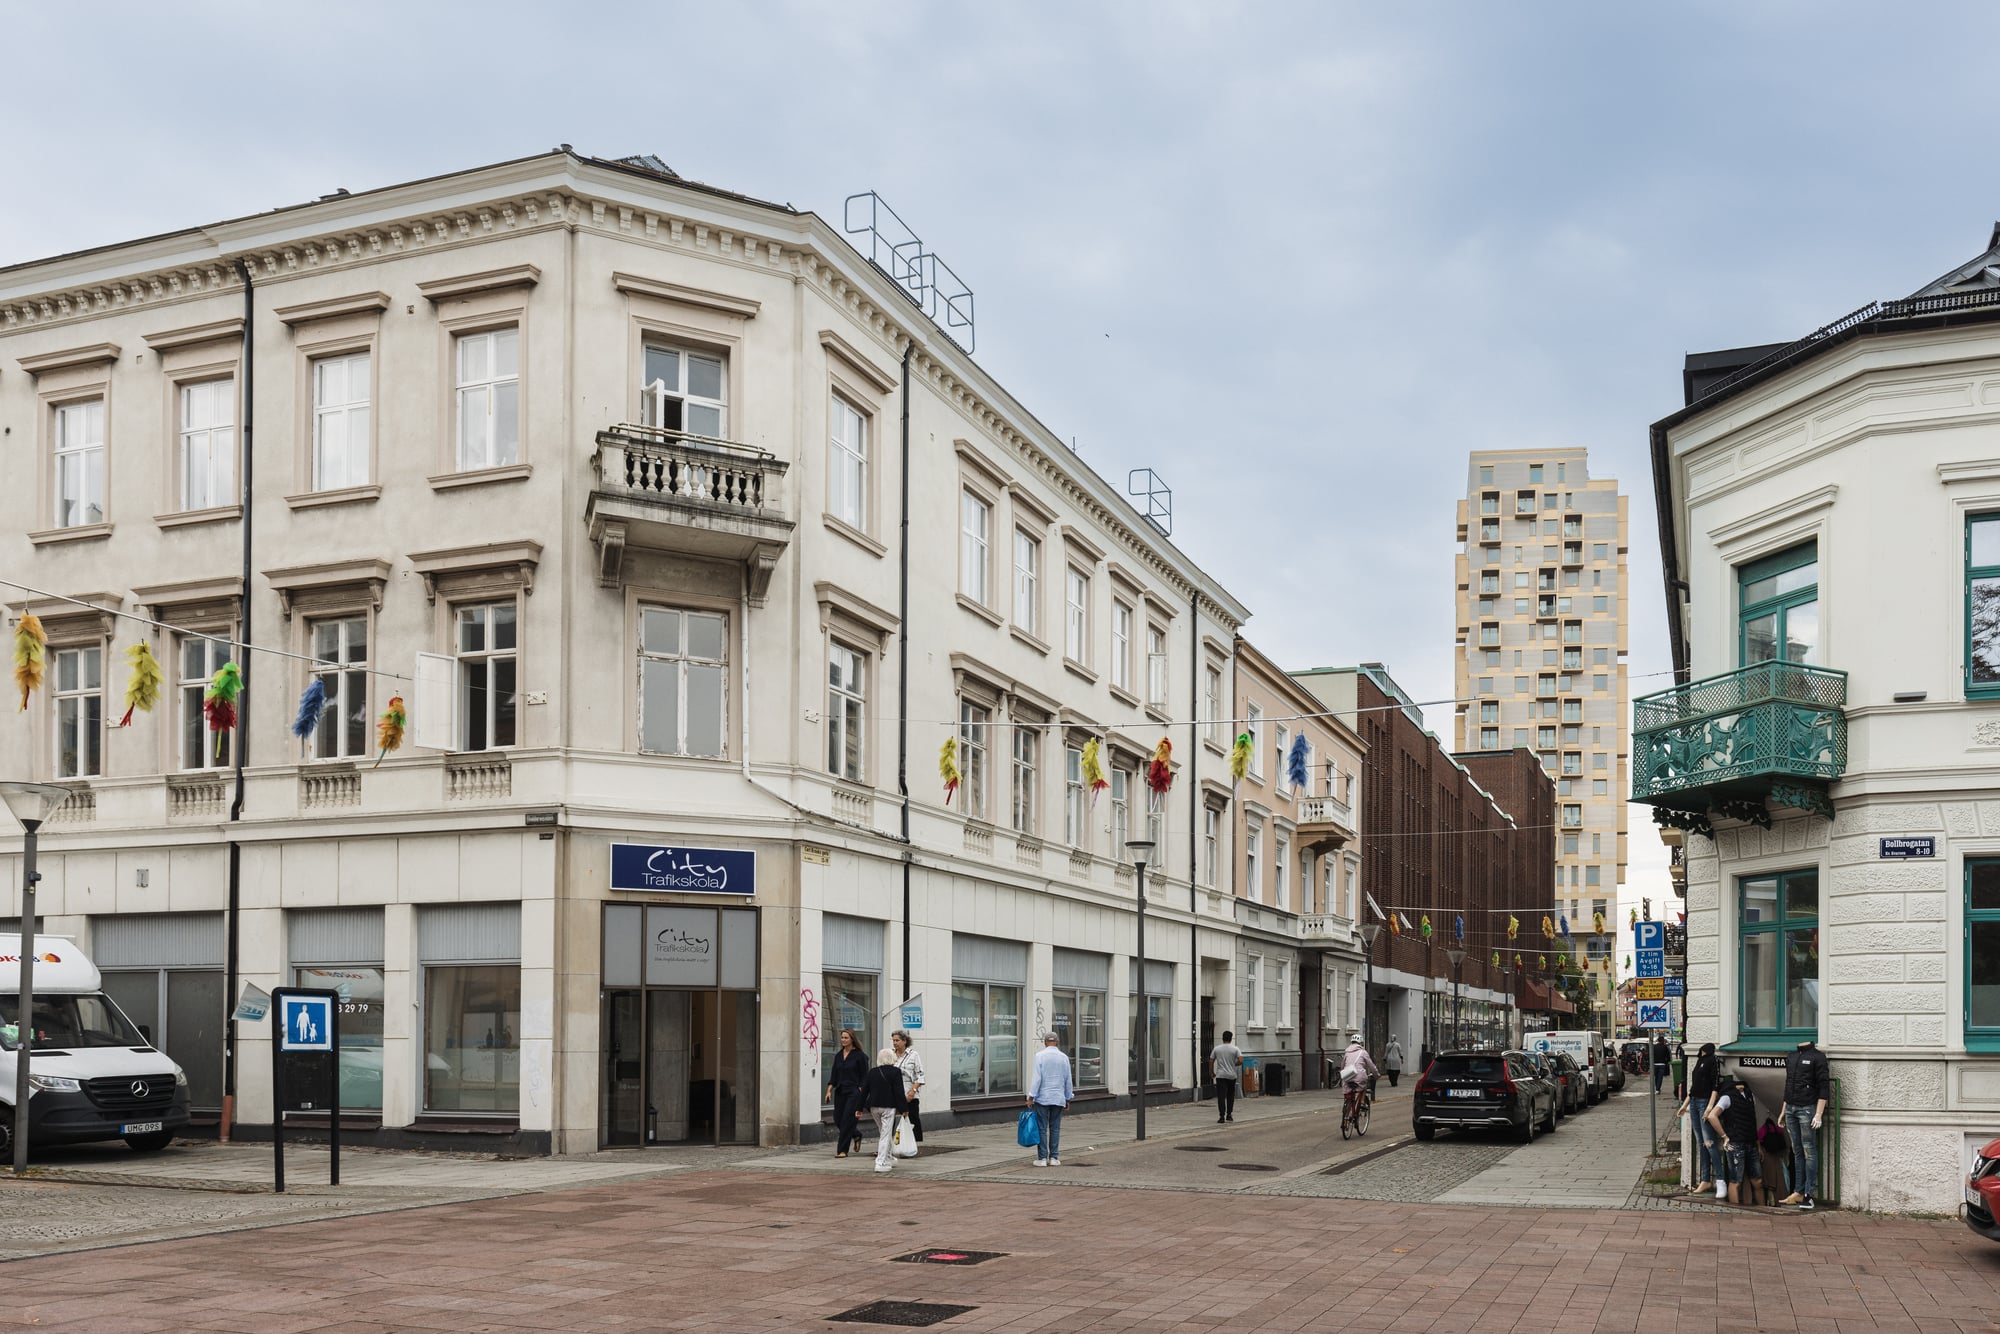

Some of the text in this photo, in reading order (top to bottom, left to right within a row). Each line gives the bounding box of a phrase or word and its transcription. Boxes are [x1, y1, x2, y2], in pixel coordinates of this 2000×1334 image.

[1885, 840, 1930, 849] Bollbrogatan
[1915, 847, 1930, 855] 8-10
[647, 849, 728, 889] City
[641, 872, 720, 889] Trafikskola
[1640, 924, 1657, 947] P
[657, 928, 709, 954] City
[654, 944, 704, 953] Trafikskola
[1640, 957, 1660, 965] Avgift
[345, 1004, 355, 1013] 29
[358, 1004, 368, 1013] 79
[902, 1013, 921, 1022] STR
[1743, 1057, 1786, 1067] SECOND HA
[127, 1124, 143, 1132] UMG
